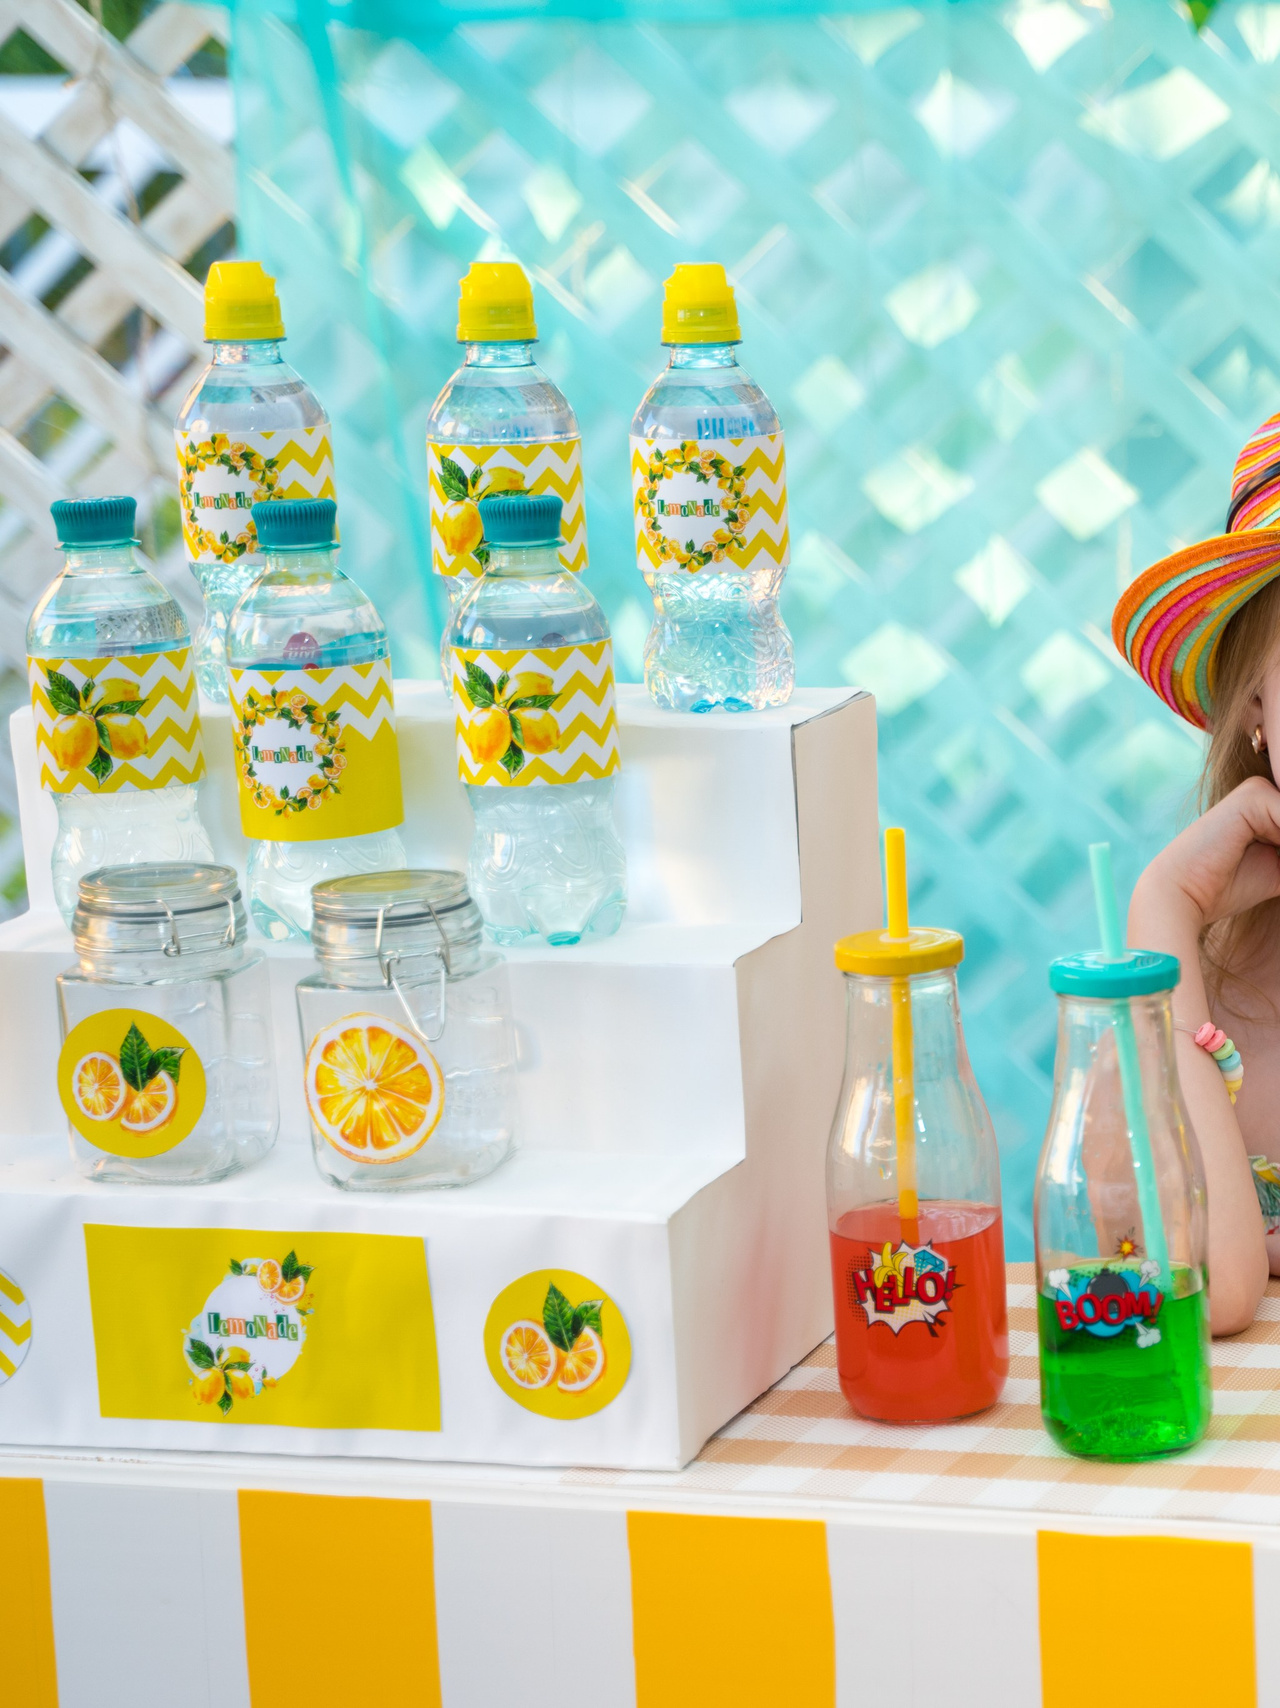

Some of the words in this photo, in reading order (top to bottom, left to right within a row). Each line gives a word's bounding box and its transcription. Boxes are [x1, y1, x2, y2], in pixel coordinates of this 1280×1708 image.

[194, 492, 252, 509] LemoNade
[658, 499, 720, 517] LemoNade
[252, 745, 313, 763] LemoNade
[852, 1266, 956, 1314] HELLO!
[1054, 1291, 1164, 1330] BOOM!
[208, 1312, 298, 1341] LemoNade
